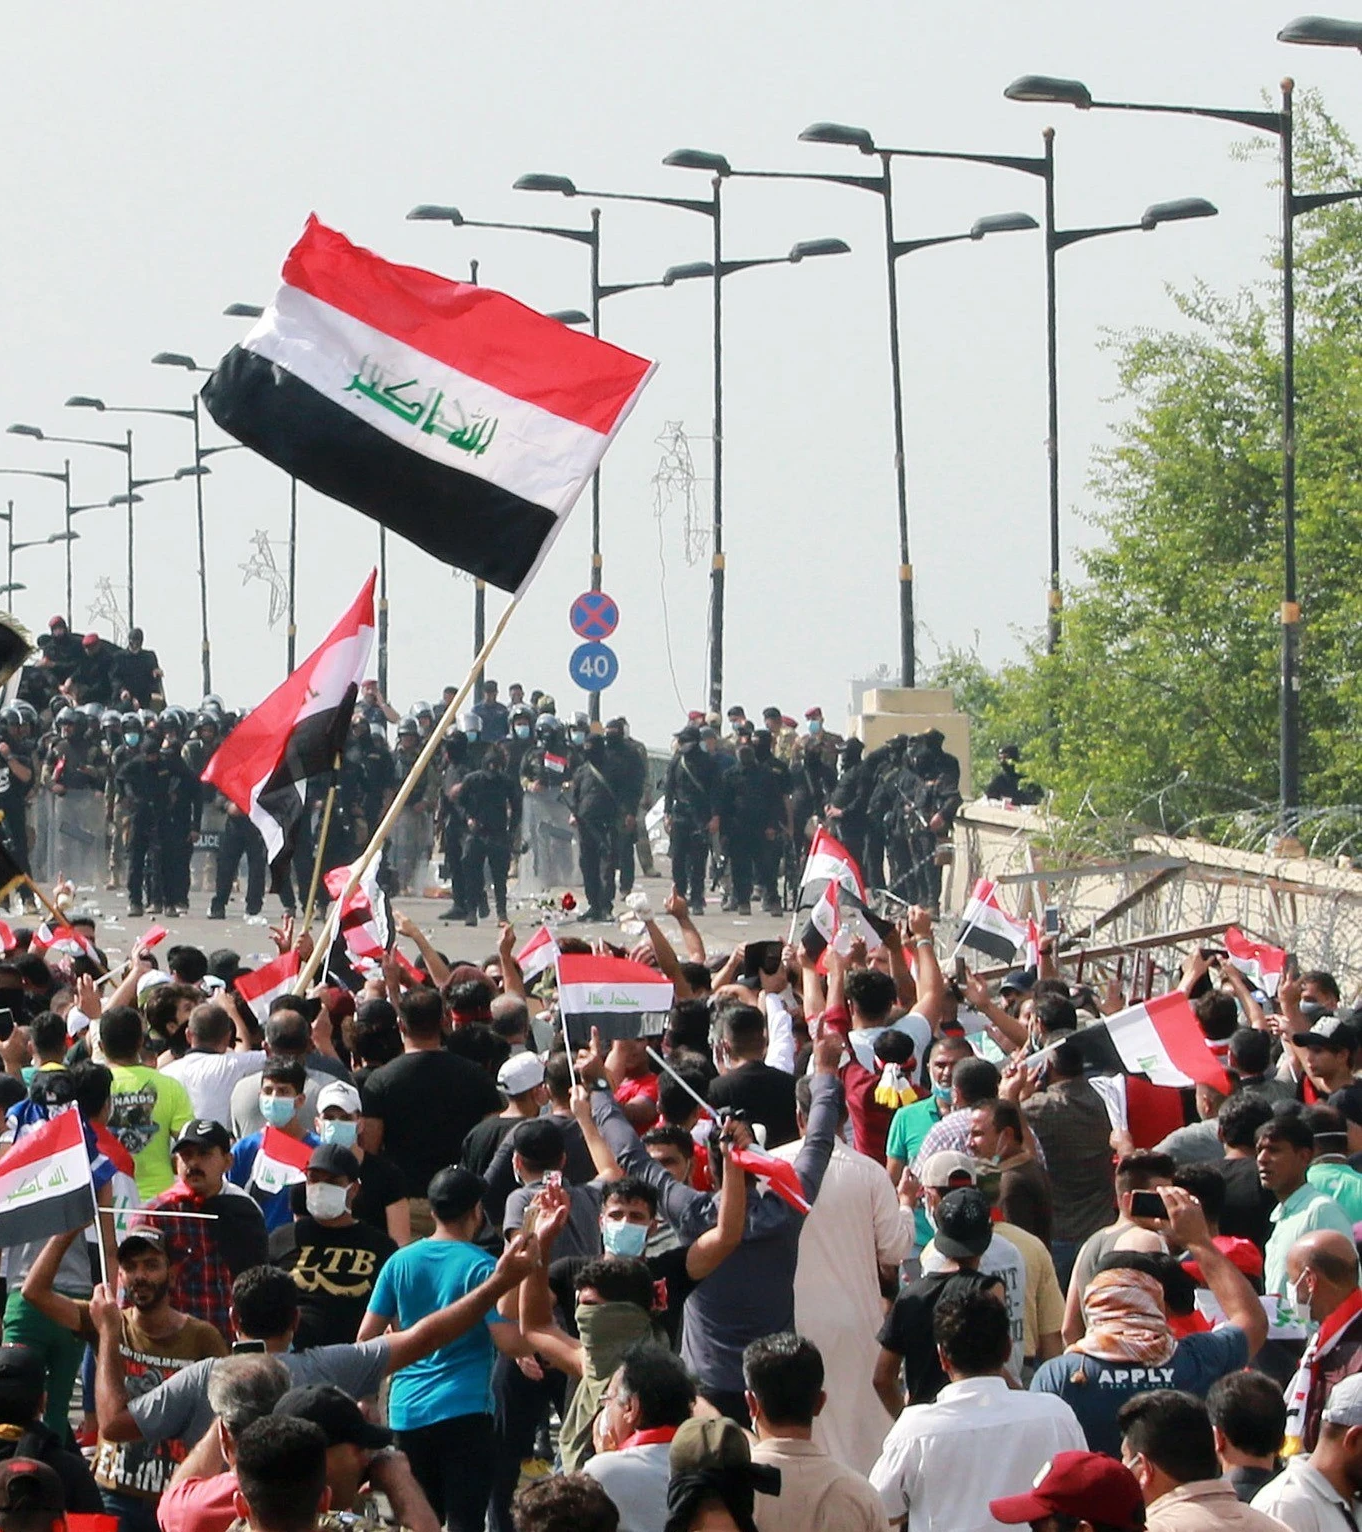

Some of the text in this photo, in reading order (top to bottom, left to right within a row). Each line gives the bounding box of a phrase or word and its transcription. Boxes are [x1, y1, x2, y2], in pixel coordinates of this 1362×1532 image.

[579, 655, 609, 678] 40
[295, 1246, 377, 1276] LTB
[1098, 1368, 1175, 1384] APPLY
